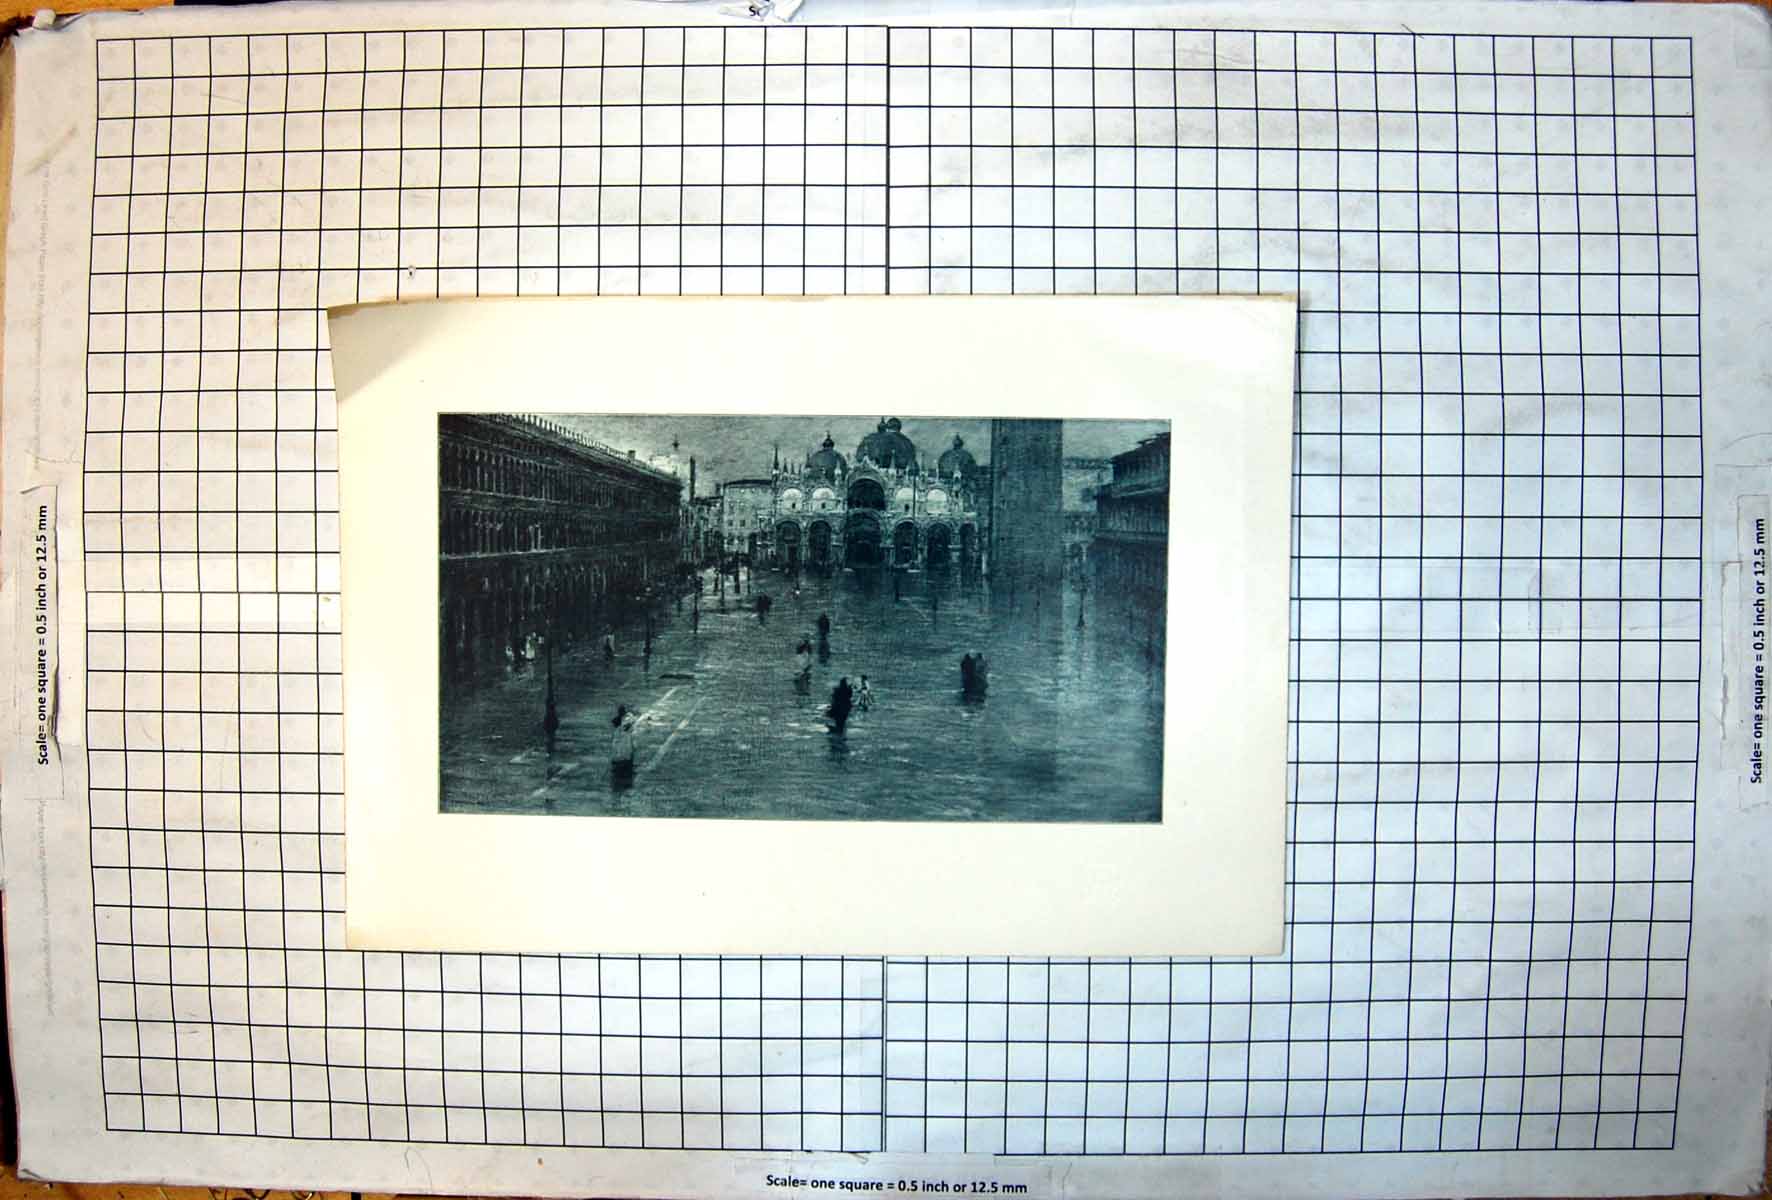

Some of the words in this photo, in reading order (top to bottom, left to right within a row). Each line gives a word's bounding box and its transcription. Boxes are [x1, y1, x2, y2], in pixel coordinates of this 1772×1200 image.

[38, 505, 47, 531] mm
[1755, 518, 1765, 545] mm
[36, 534, 47, 562] 12.5
[38, 566, 47, 580] or
[1753, 548, 1766, 576] 12.5
[36, 583, 47, 611] inch
[1756, 580, 1766, 595] or
[36, 614, 47, 635] 0.5
[1753, 598, 1765, 626] inch
[1753, 630, 1765, 651] 0.5
[38, 649, 48, 694] square
[1754, 665, 1766, 711] square
[38, 696, 47, 722] one
[1753, 713, 1764, 739] one
[36, 725, 49, 766] Scale=
[1750, 742, 1763, 784] Scale=
[766, 1174, 807, 1188] Scale=
[810, 1179, 836, 1190] one
[839, 1180, 884, 1193] square
[897, 1180, 919, 1192] 0.5
[922, 1180, 950, 1193] inch
[952, 1183, 968, 1193] or
[970, 1181, 999, 1194] 12.5
[1001, 1184, 1028, 1194] mm
